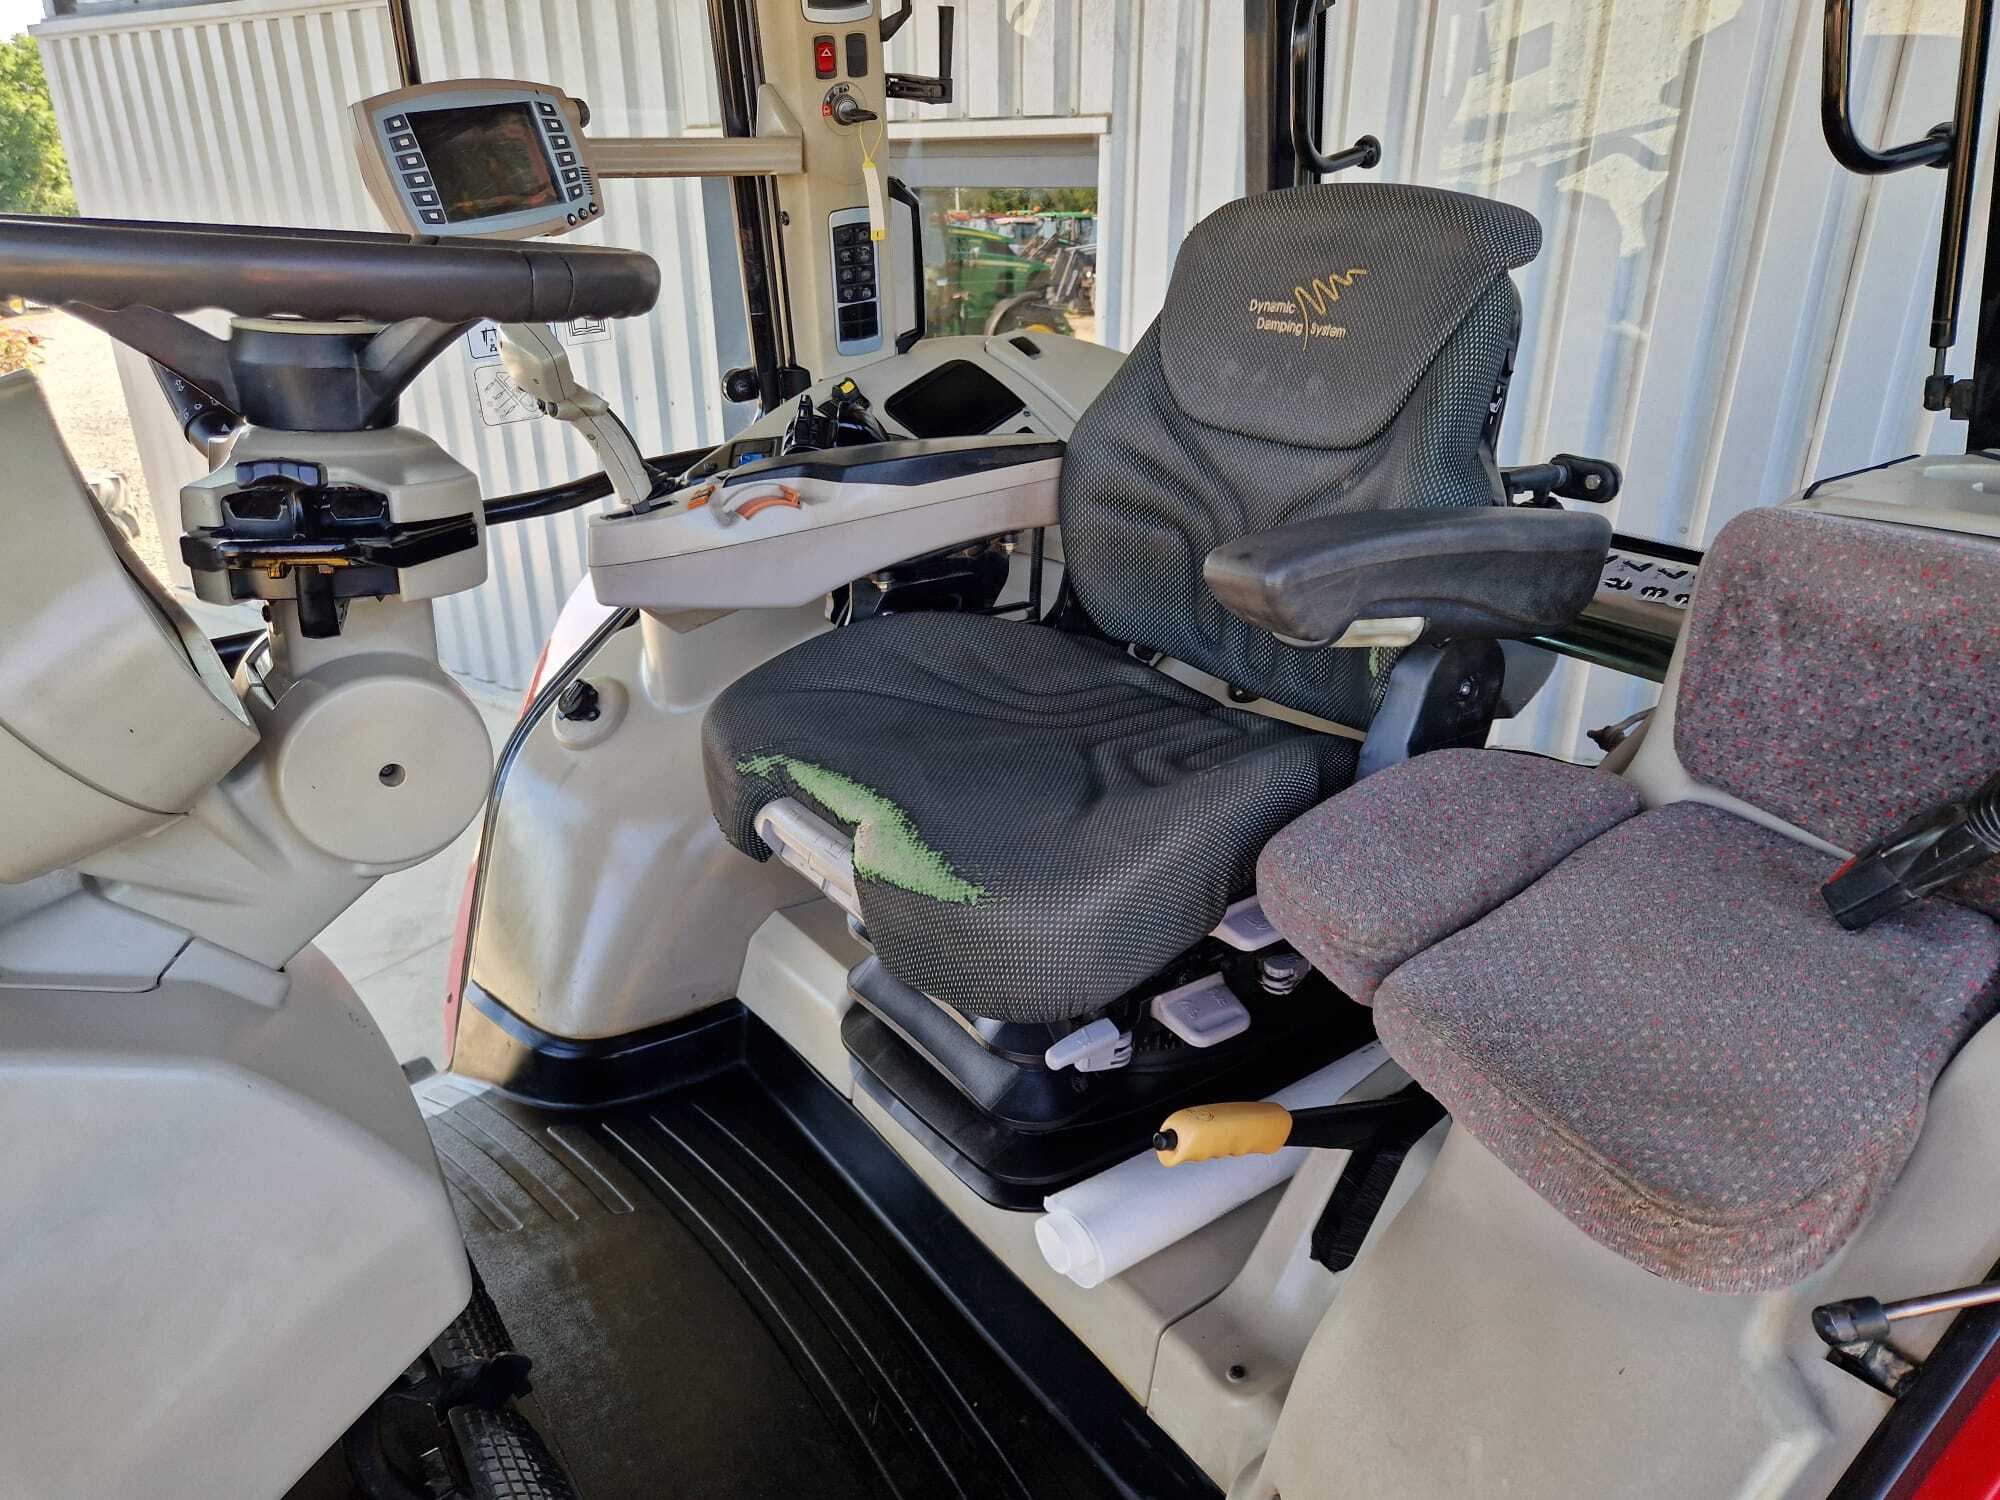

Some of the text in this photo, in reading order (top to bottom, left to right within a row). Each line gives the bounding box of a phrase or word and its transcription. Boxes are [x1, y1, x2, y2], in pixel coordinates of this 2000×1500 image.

[1249, 299, 1297, 314] Dynamic
[1256, 317, 1346, 338] Damping System
